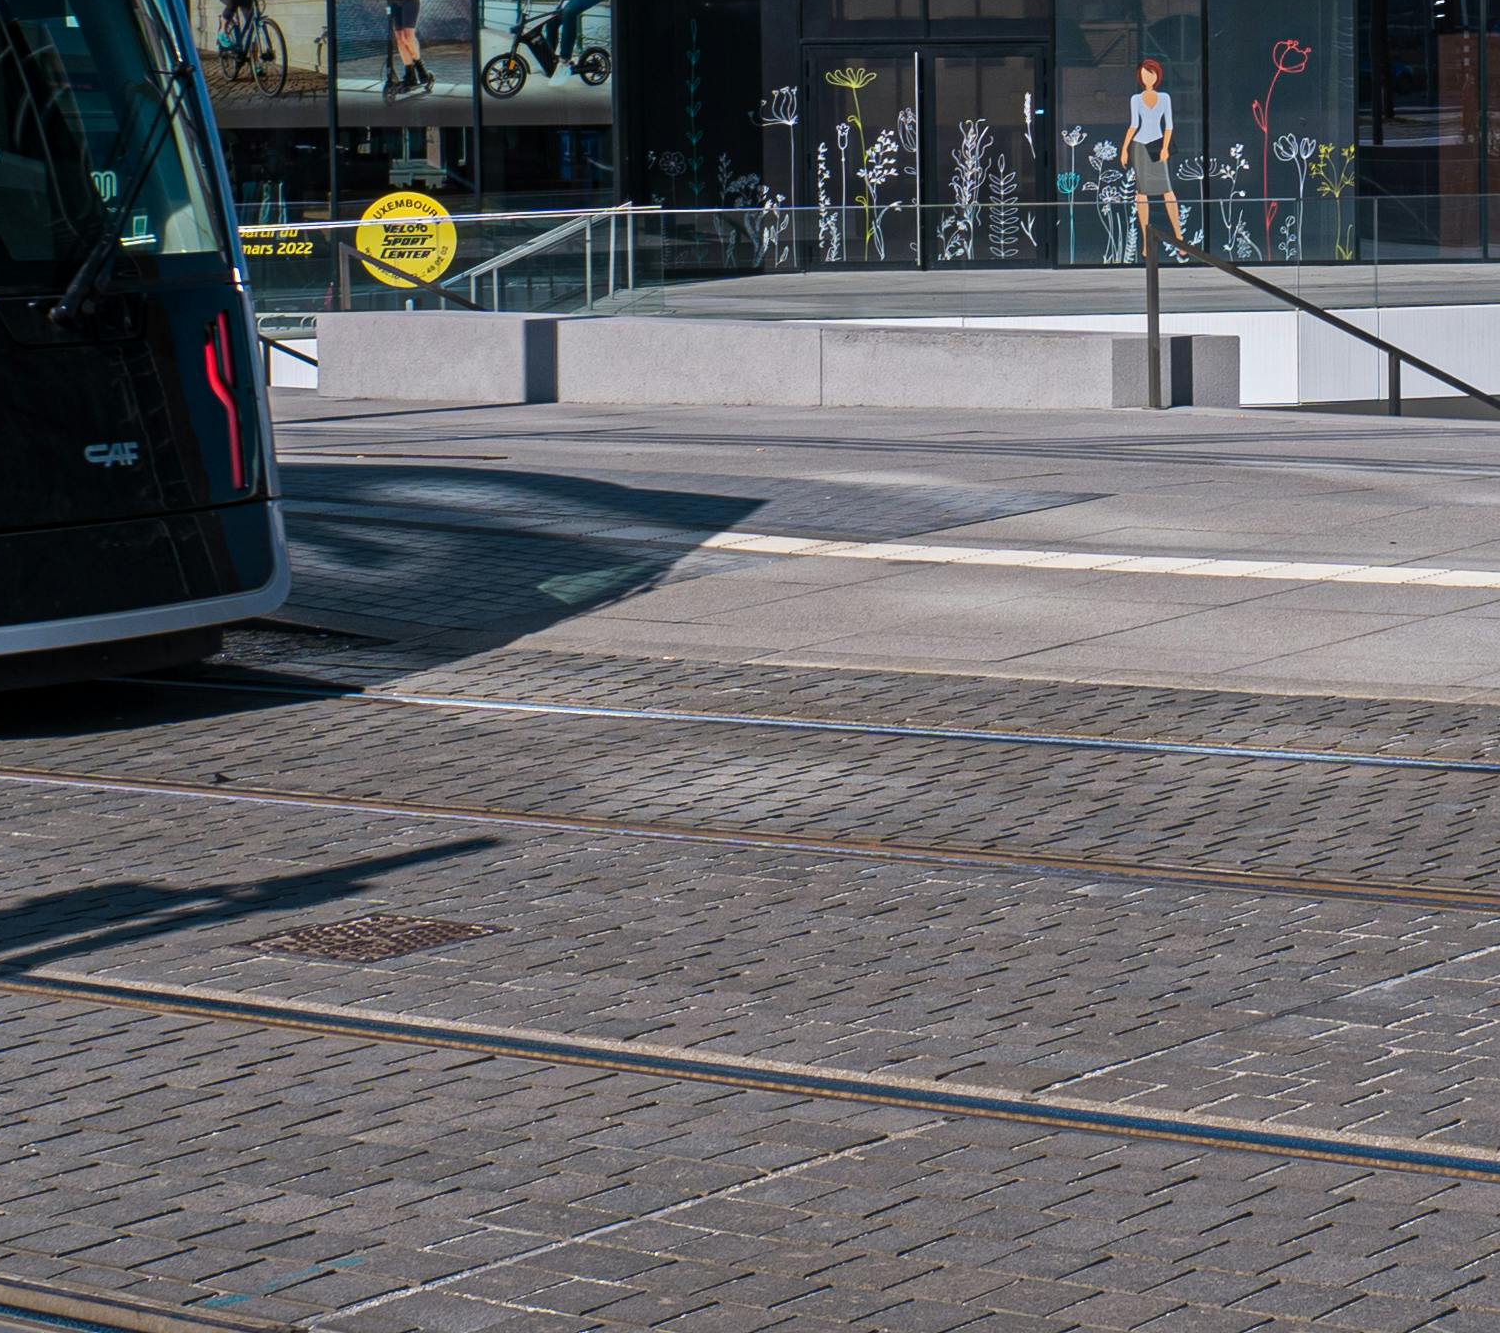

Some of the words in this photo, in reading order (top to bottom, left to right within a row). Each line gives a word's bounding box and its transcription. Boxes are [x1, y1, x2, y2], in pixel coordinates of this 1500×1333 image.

[370, 199, 440, 221] UXEMBOUR
[381, 235, 434, 247] SPORT
[276, 242, 314, 255] 2022
[380, 247, 437, 259] CENTER
[84, 442, 139, 468] CAF
